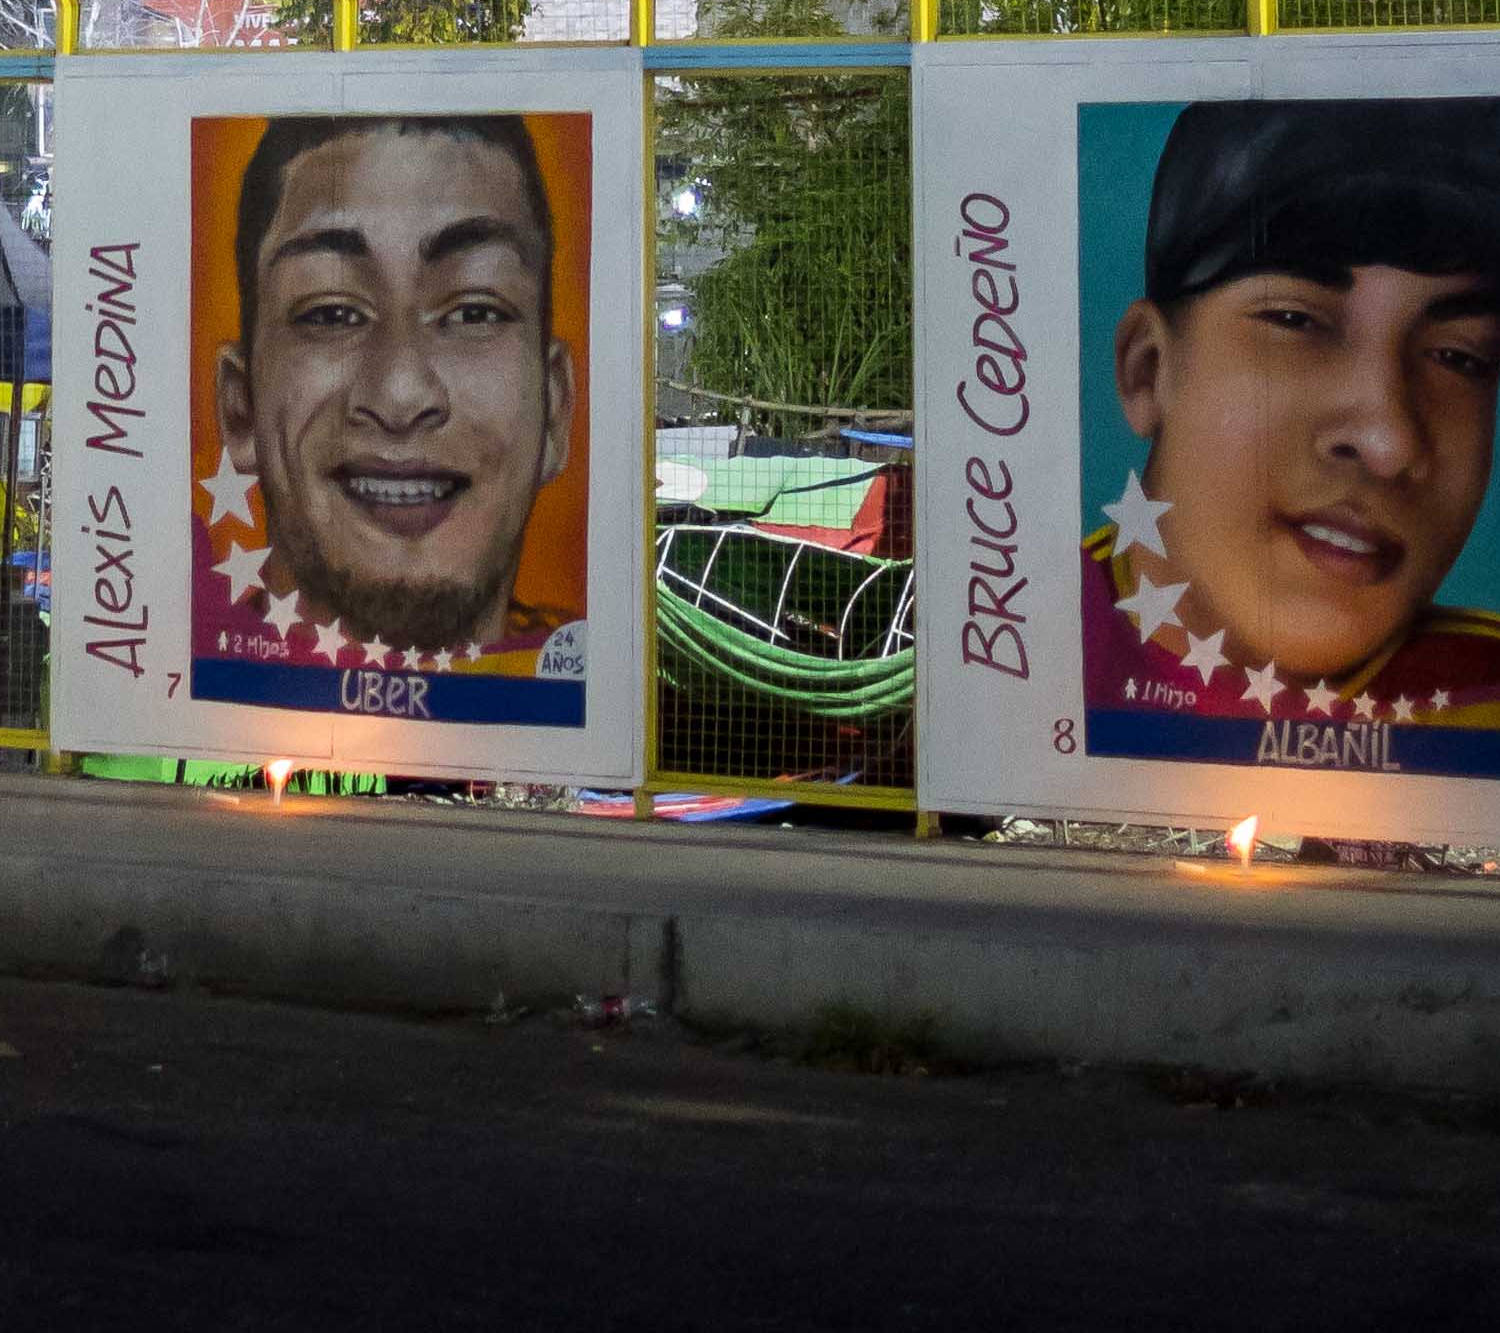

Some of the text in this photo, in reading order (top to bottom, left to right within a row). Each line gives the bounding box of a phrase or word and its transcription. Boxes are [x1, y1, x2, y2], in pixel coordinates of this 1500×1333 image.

[232, 635, 243, 653] 2
[552, 633, 575, 647] 24
[541, 649, 585, 674] AÑOS
[166, 672, 182, 699] 7
[1053, 717, 1077, 755] 8
